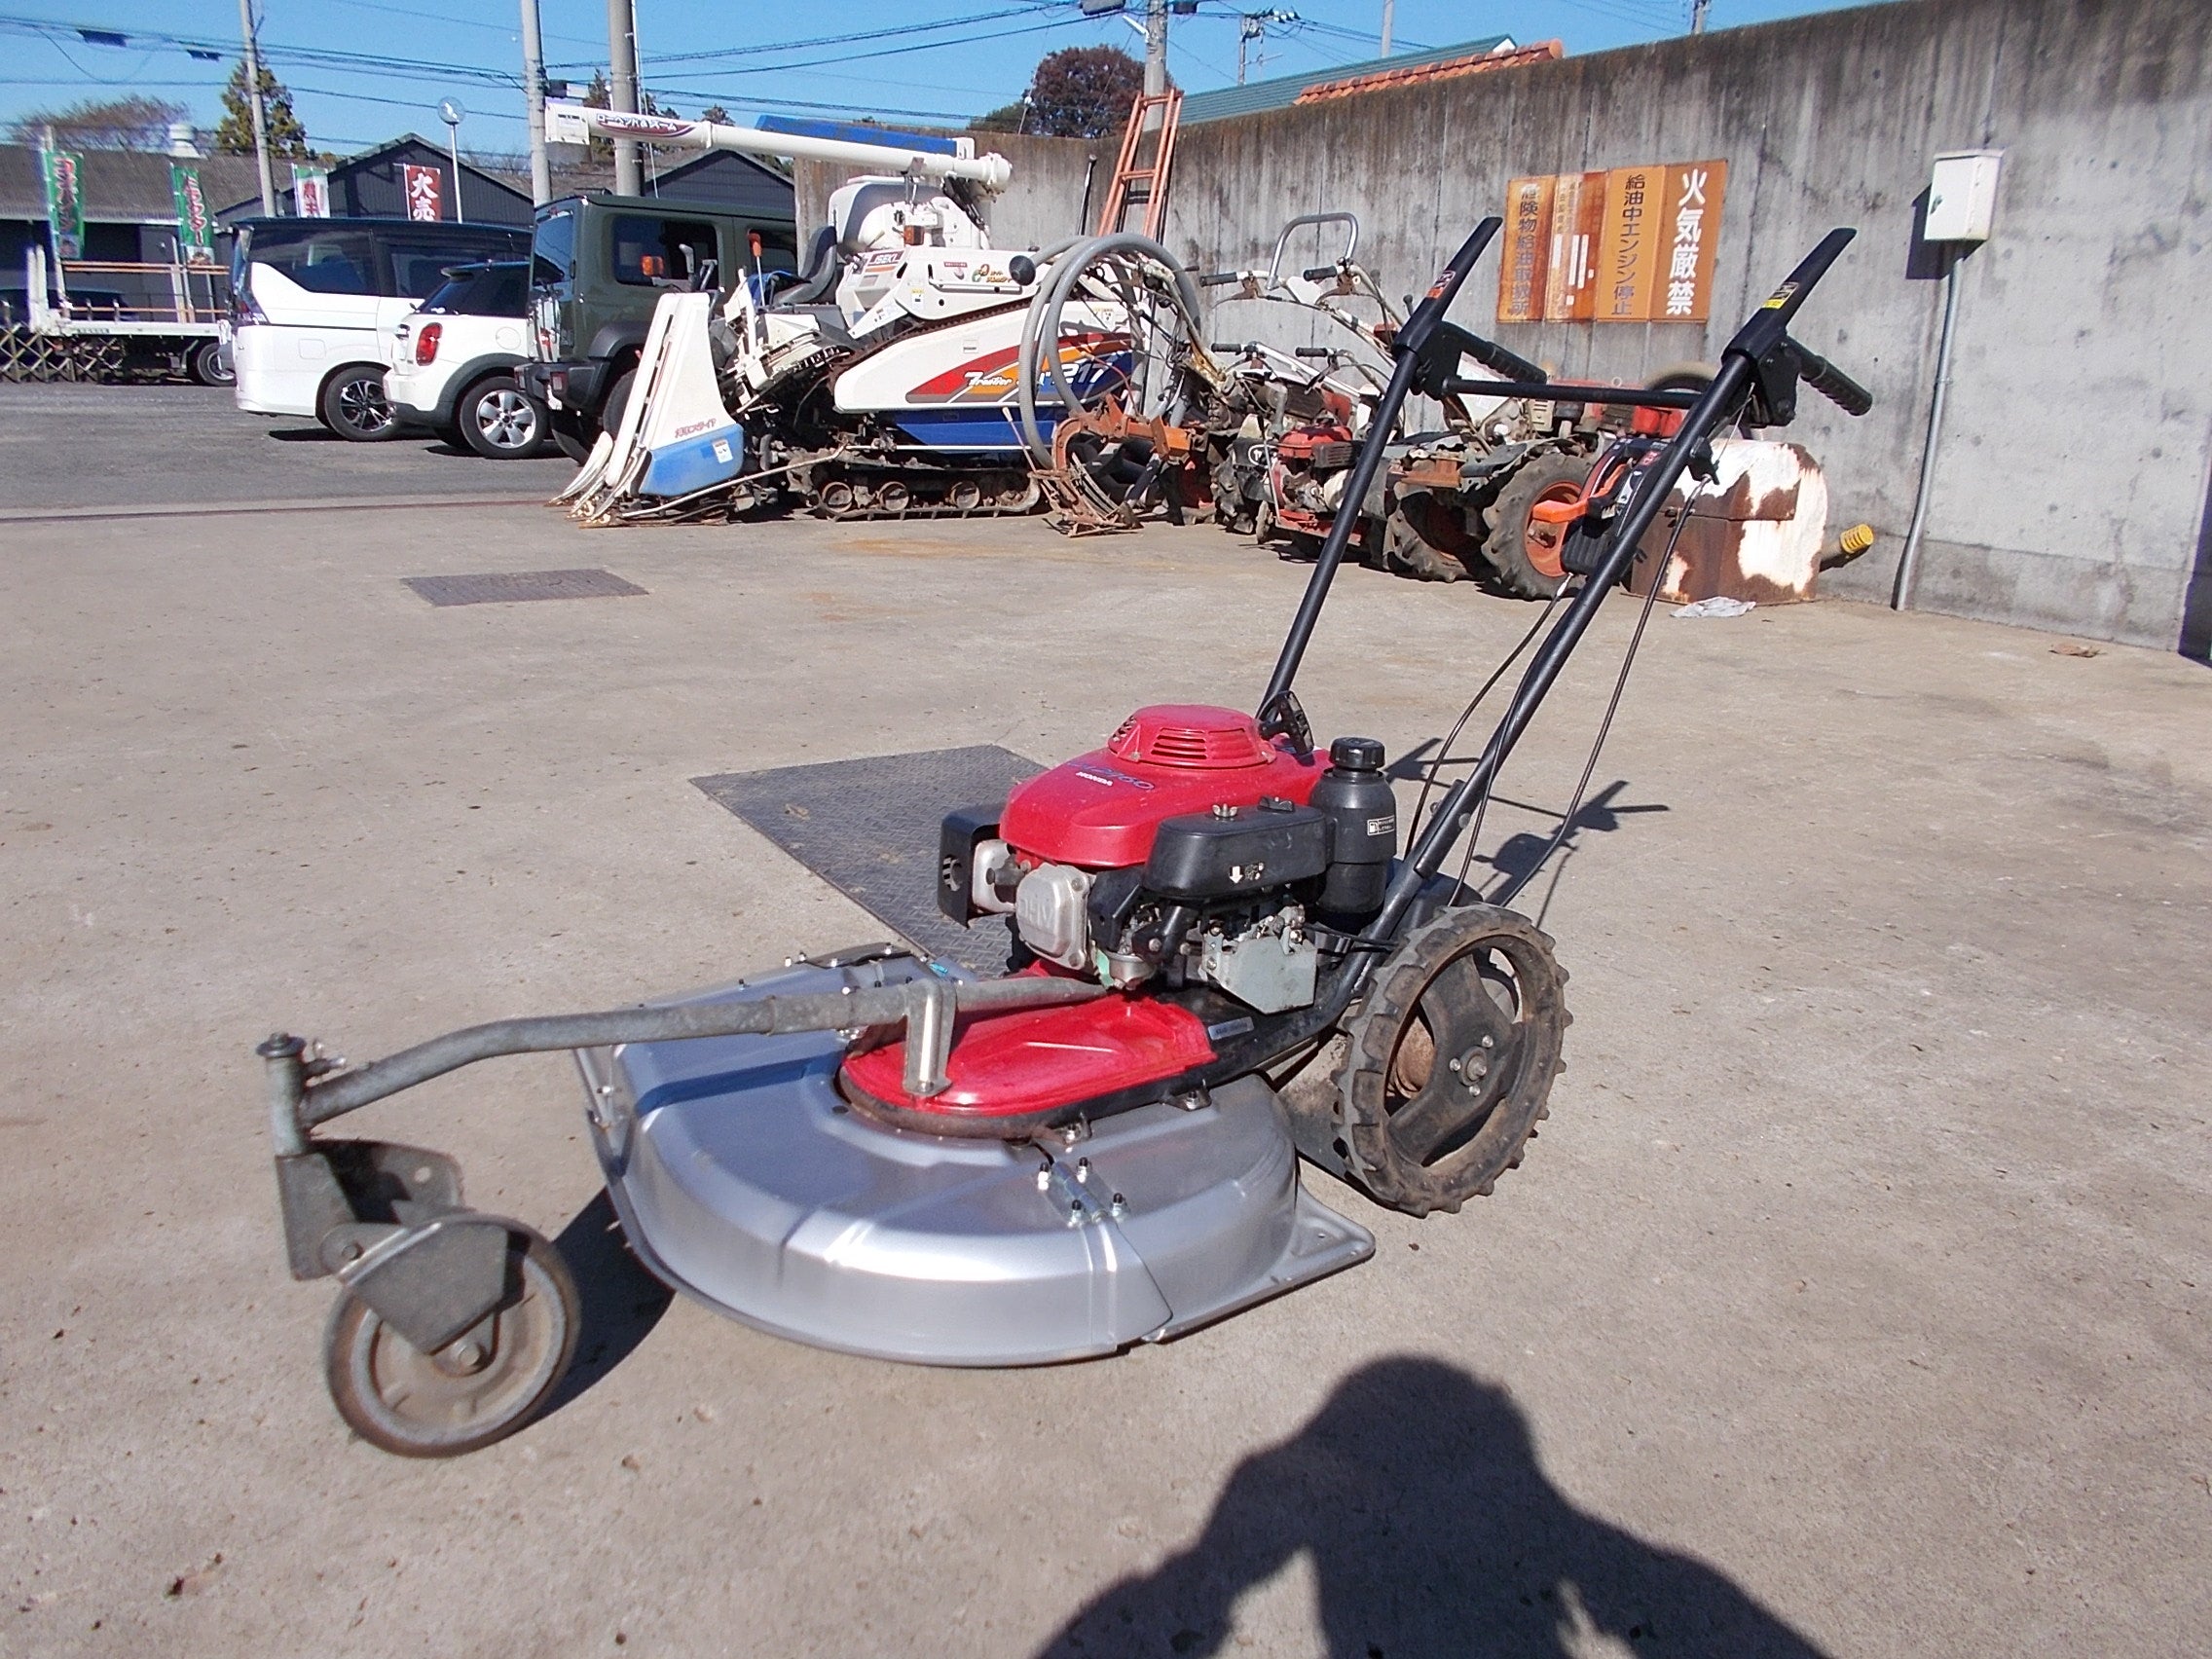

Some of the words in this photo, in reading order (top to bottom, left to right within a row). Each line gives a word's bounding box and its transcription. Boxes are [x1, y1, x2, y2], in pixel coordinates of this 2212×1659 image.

[1611, 173, 1646, 316] 給油中エンジン停止
[1666, 167, 1708, 316] 火気厳禁
